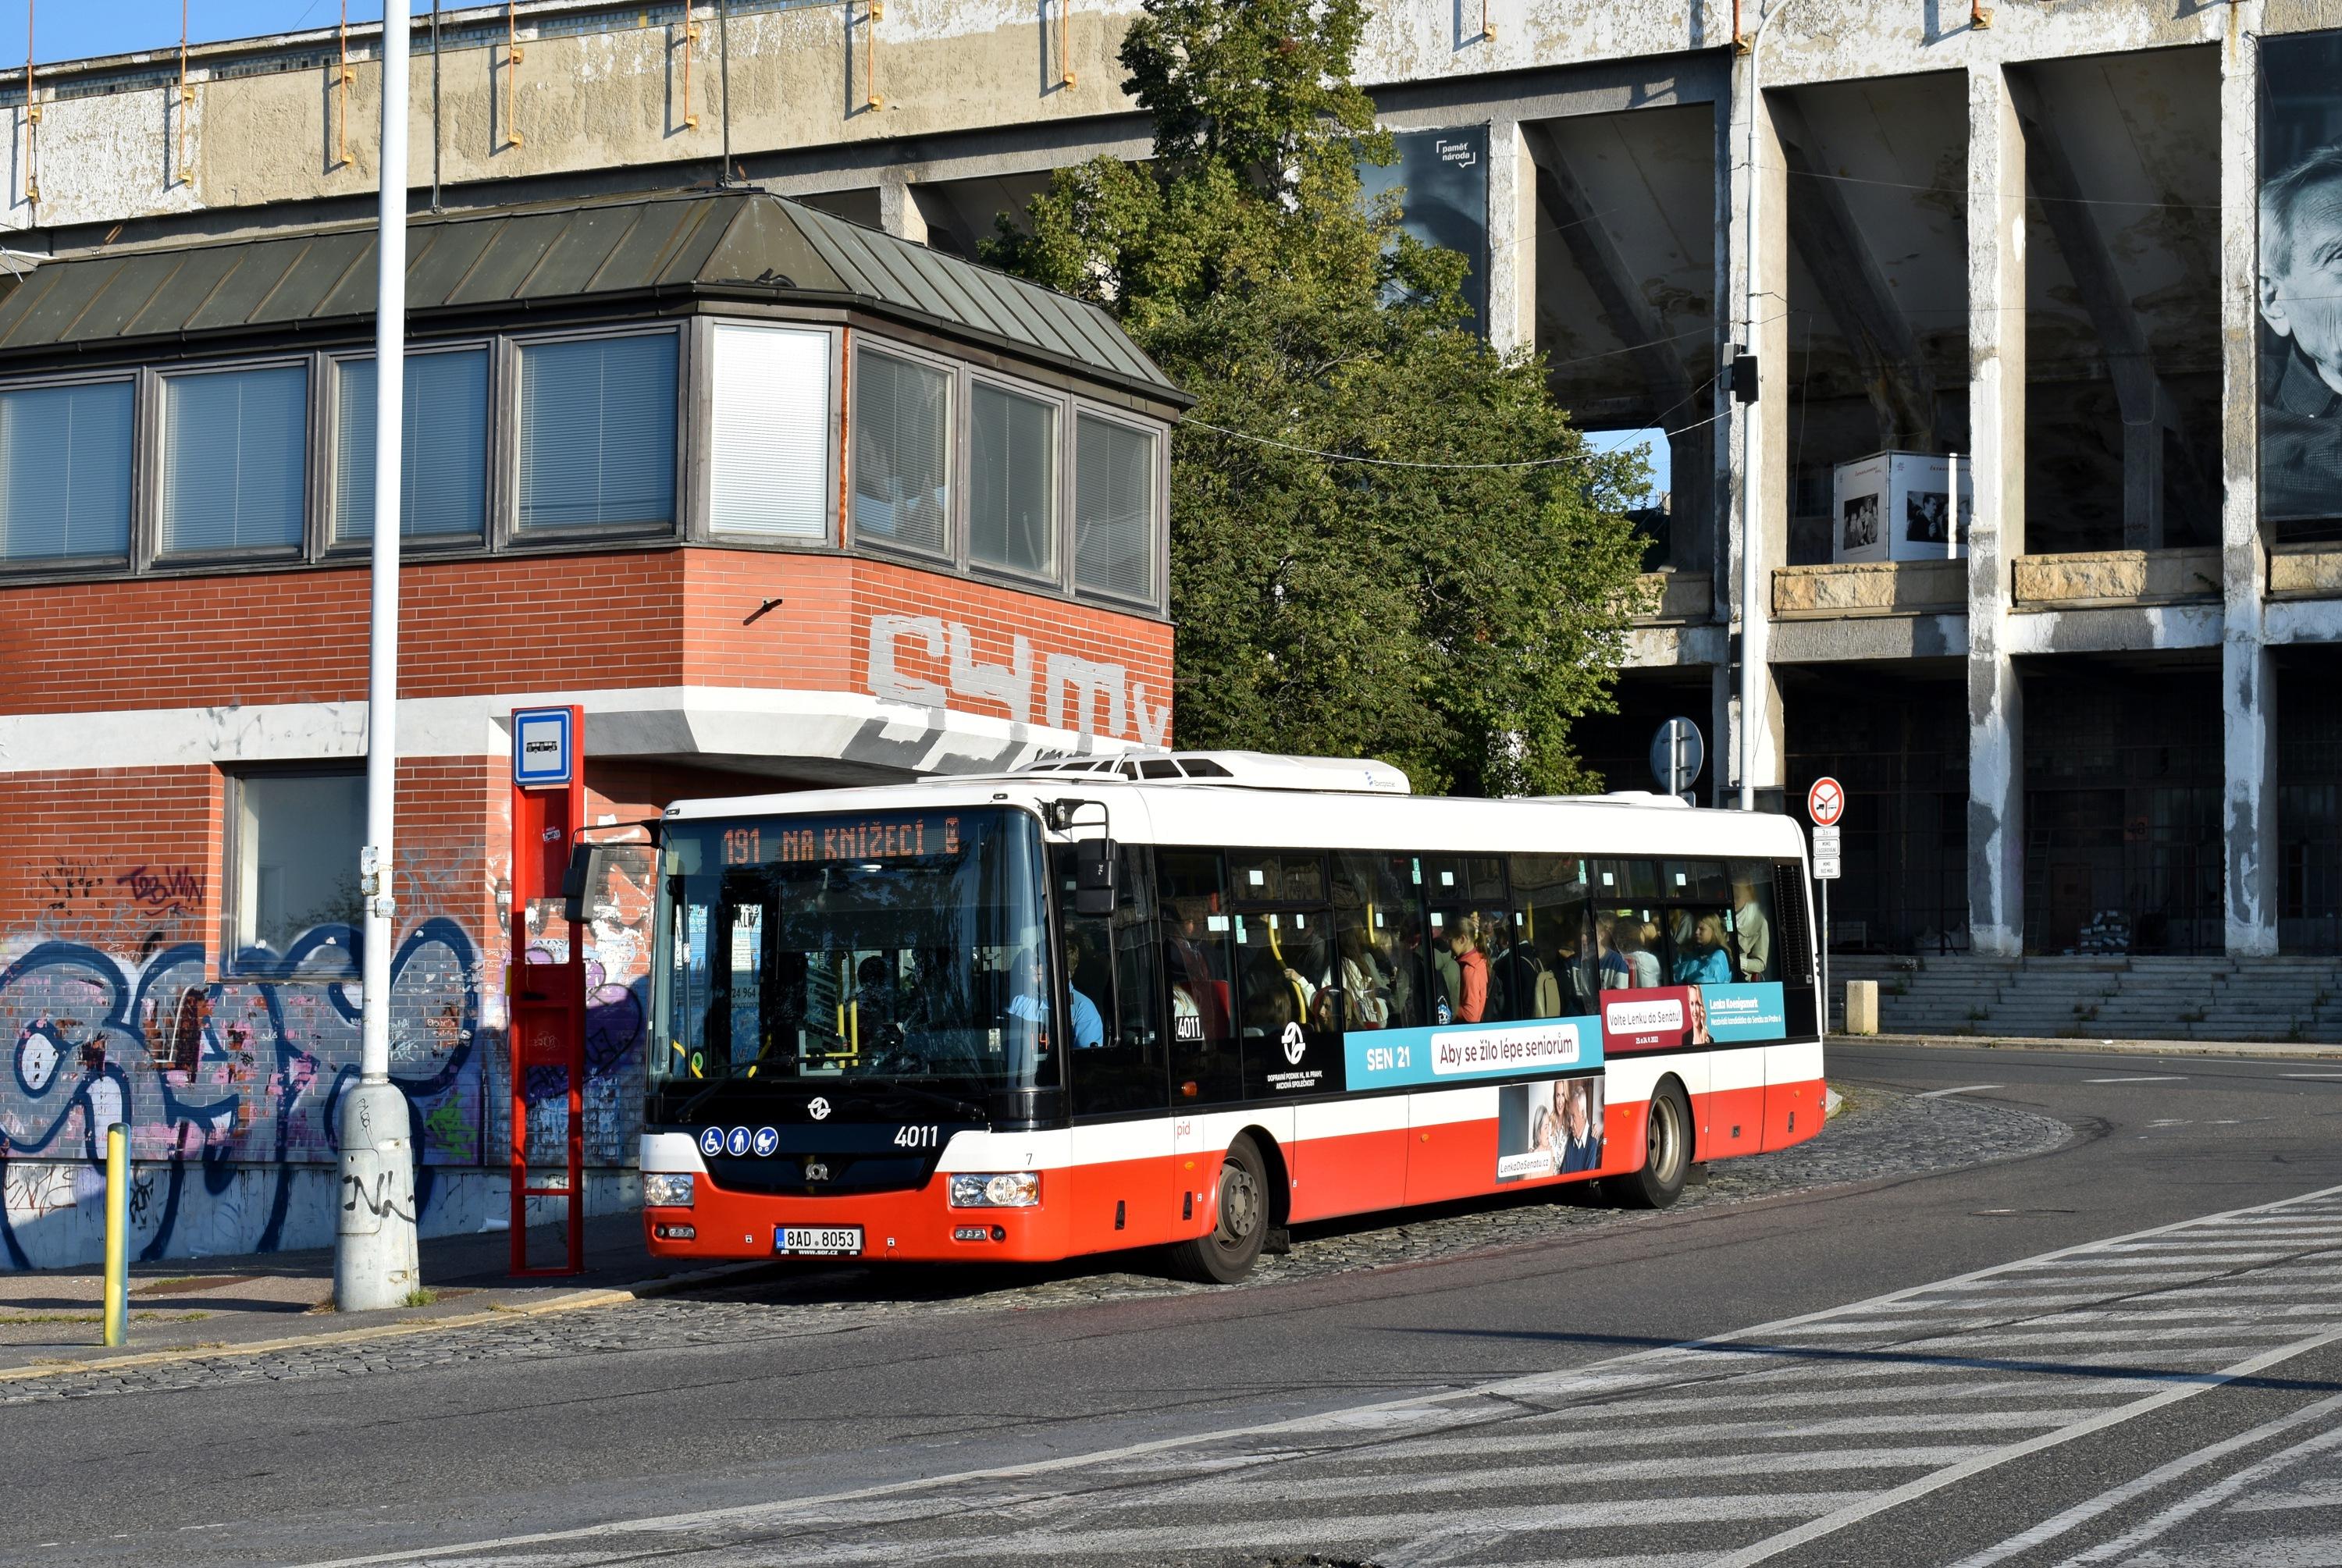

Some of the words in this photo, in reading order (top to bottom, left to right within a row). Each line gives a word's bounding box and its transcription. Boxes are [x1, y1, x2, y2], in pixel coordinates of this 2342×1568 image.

[1443, 142, 1468, 154] paměť
[1443, 151, 1470, 161] národa
[724, 828, 760, 865] 191
[782, 830, 813, 862] NA
[824, 820, 924, 860] KNÍŽECÍ
[1609, 1014, 1626, 1026] Volte
[1628, 1012, 1647, 1025] Lenku
[1648, 1012, 1657, 1024] do
[1658, 1009, 1681, 1023] Senátu!
[1177, 1016, 1201, 1038] 4011
[1440, 1044, 1461, 1066] Aby
[1465, 1047, 1477, 1062] se
[1480, 1039, 1498, 1061] žilo
[1500, 1037, 1522, 1062] lépe
[1525, 1032, 1573, 1057] seniorům
[1367, 1047, 1393, 1071] SEN
[1397, 1046, 1411, 1068] 21
[894, 1125, 938, 1147] 4011
[1176, 1121, 1191, 1140] pid
[1026, 1153, 1032, 1165] 7
[1500, 1158, 1549, 1173] LenkaDoSenatu.cz
[787, 1231, 811, 1246] 8AD
[822, 1232, 854, 1246] 8053
